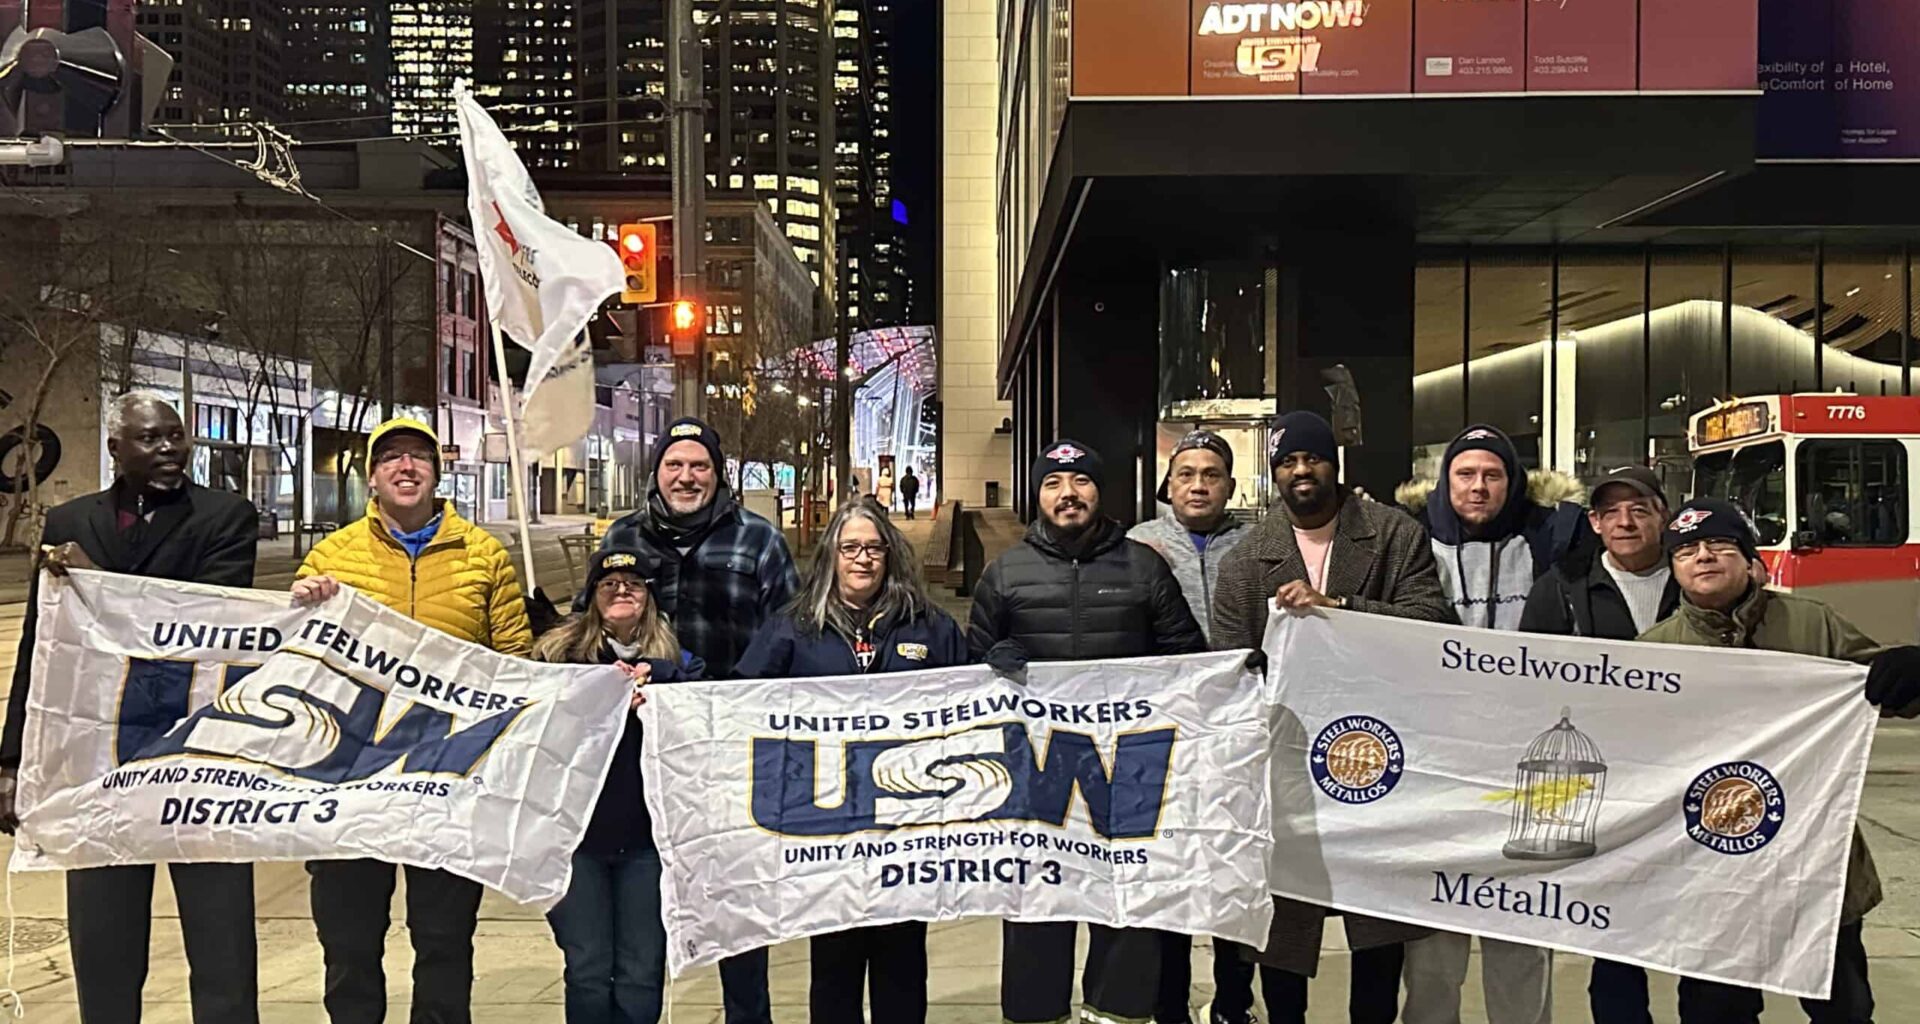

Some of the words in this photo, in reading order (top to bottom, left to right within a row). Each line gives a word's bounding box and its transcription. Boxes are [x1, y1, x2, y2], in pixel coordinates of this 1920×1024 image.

[1198, 3, 1269, 35] ADT
[1270, 0, 1364, 31] NOW!
[1236, 43, 1321, 76] USW
[1811, 61, 1825, 73] of
[1835, 63, 1843, 73] a
[1850, 61, 1890, 74] Hotel,
[1835, 79, 1848, 90] of
[1853, 79, 1894, 91] Home
[1827, 406, 1867, 420] 7776
[152, 622, 283, 652] UNITED
[296, 618, 531, 712] TEELWORKERS
[1440, 639, 1683, 695] Steelworkers
[115, 649, 538, 784] USW
[768, 714, 891, 732] UNITED
[902, 693, 1153, 731] STEELWORKERS
[1317, 719, 1401, 761] STEELWORKERS
[102, 769, 151, 790] UNITY
[149, 766, 190, 785] AND
[749, 721, 1178, 841] USW
[160, 797, 311, 826] DISTRICT
[313, 798, 339, 824] 3
[785, 843, 848, 864] UNITY
[852, 841, 897, 859] AND
[903, 831, 1004, 852] STRENGTH
[1010, 831, 1049, 849] FOR
[1053, 837, 1148, 865] WORKERS
[880, 857, 1032, 889] DISTRICT
[1041, 860, 1062, 886] 3
[1430, 870, 1612, 931] Métallos
